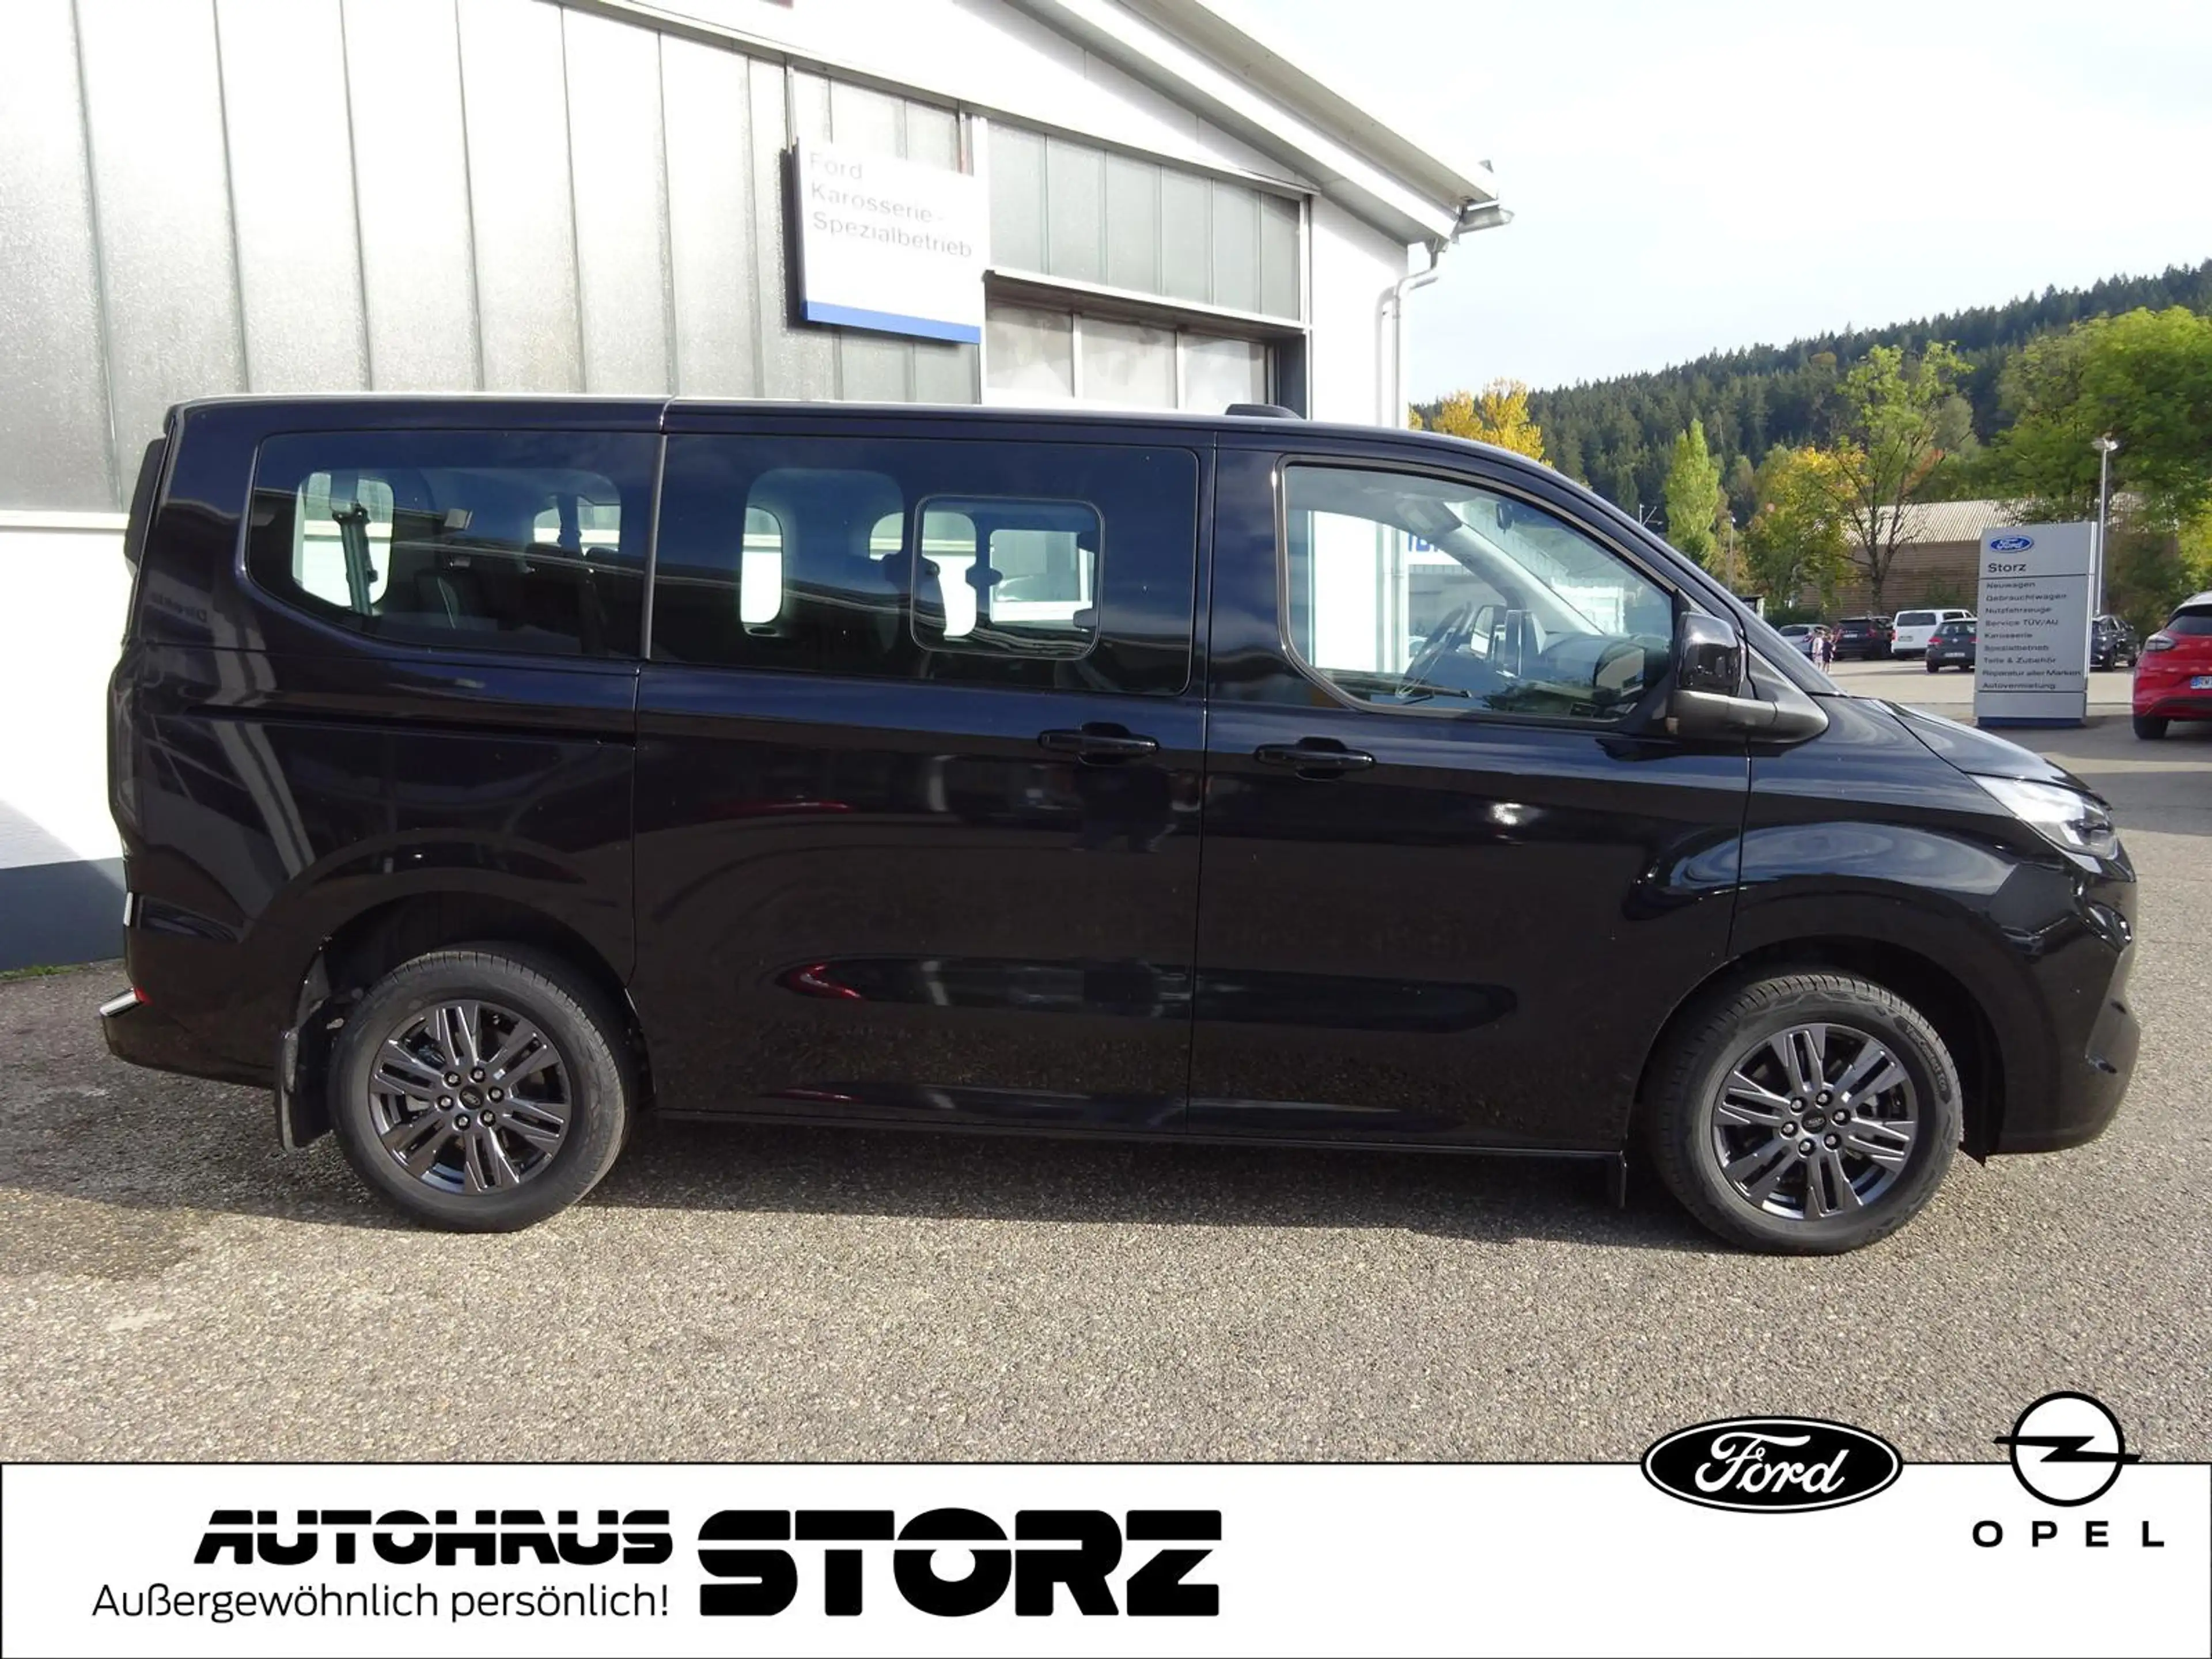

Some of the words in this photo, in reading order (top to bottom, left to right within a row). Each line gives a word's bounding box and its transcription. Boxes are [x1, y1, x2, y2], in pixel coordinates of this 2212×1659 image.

[809, 151, 863, 180] Ford
[813, 211, 972, 257] Spezialbetrieb
[1988, 562, 2027, 573] Storz
[1985, 592, 2067, 602] Gebrauchtwagen
[1985, 607, 2052, 615] Nutzfahrzeuge
[1985, 619, 2021, 627] Service
[2023, 618, 2059, 627] TÜV/AU
[1982, 682, 2056, 690] Autovermietung
